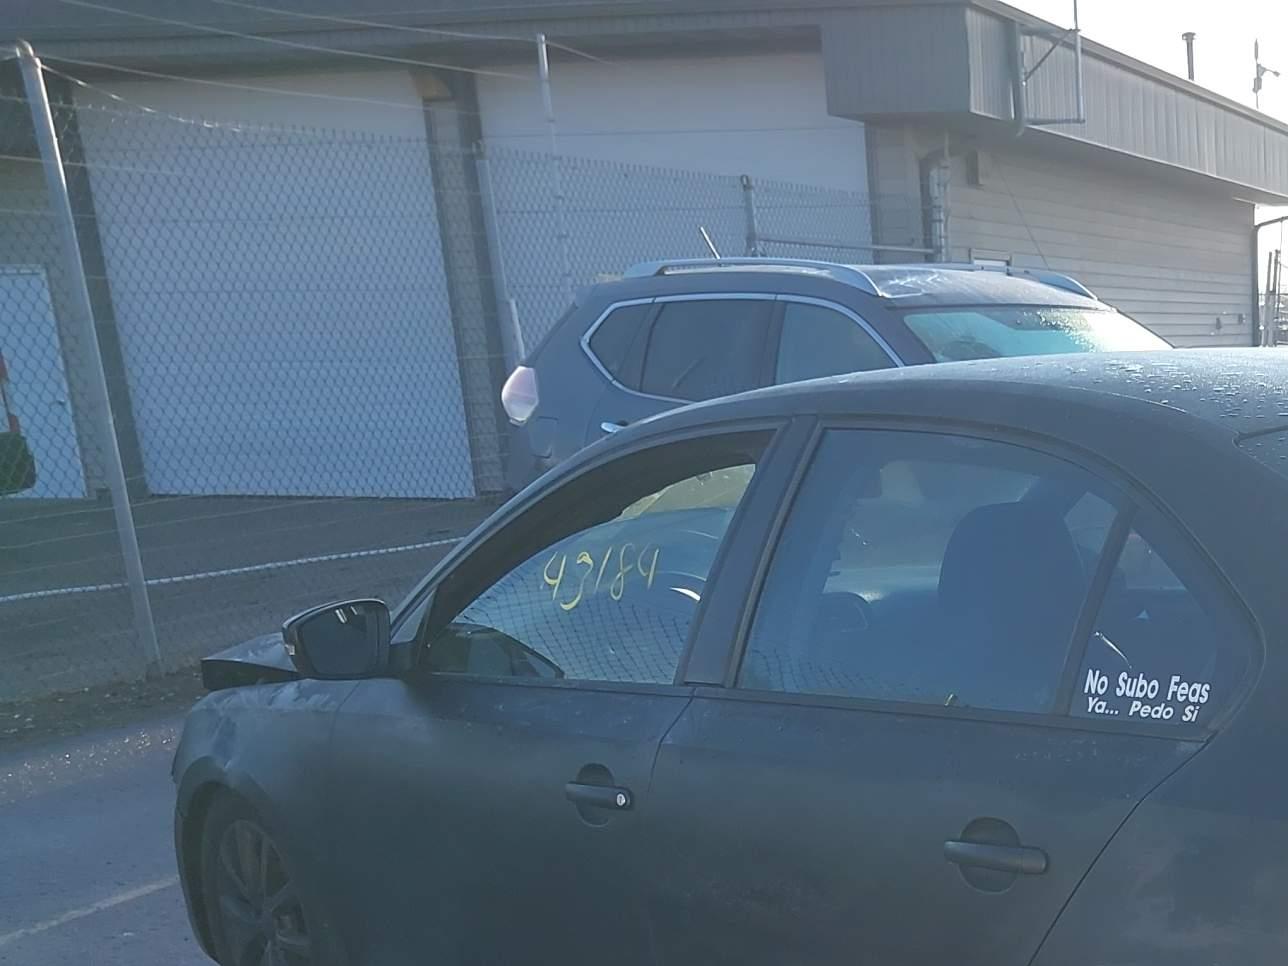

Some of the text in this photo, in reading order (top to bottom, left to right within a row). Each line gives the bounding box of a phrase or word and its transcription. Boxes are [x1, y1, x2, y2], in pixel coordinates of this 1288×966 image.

[540, 543, 659, 611] 43184
[1084, 668, 1211, 704] No Subo Feas
[1087, 697, 1200, 722] Ya... Pedo Si
